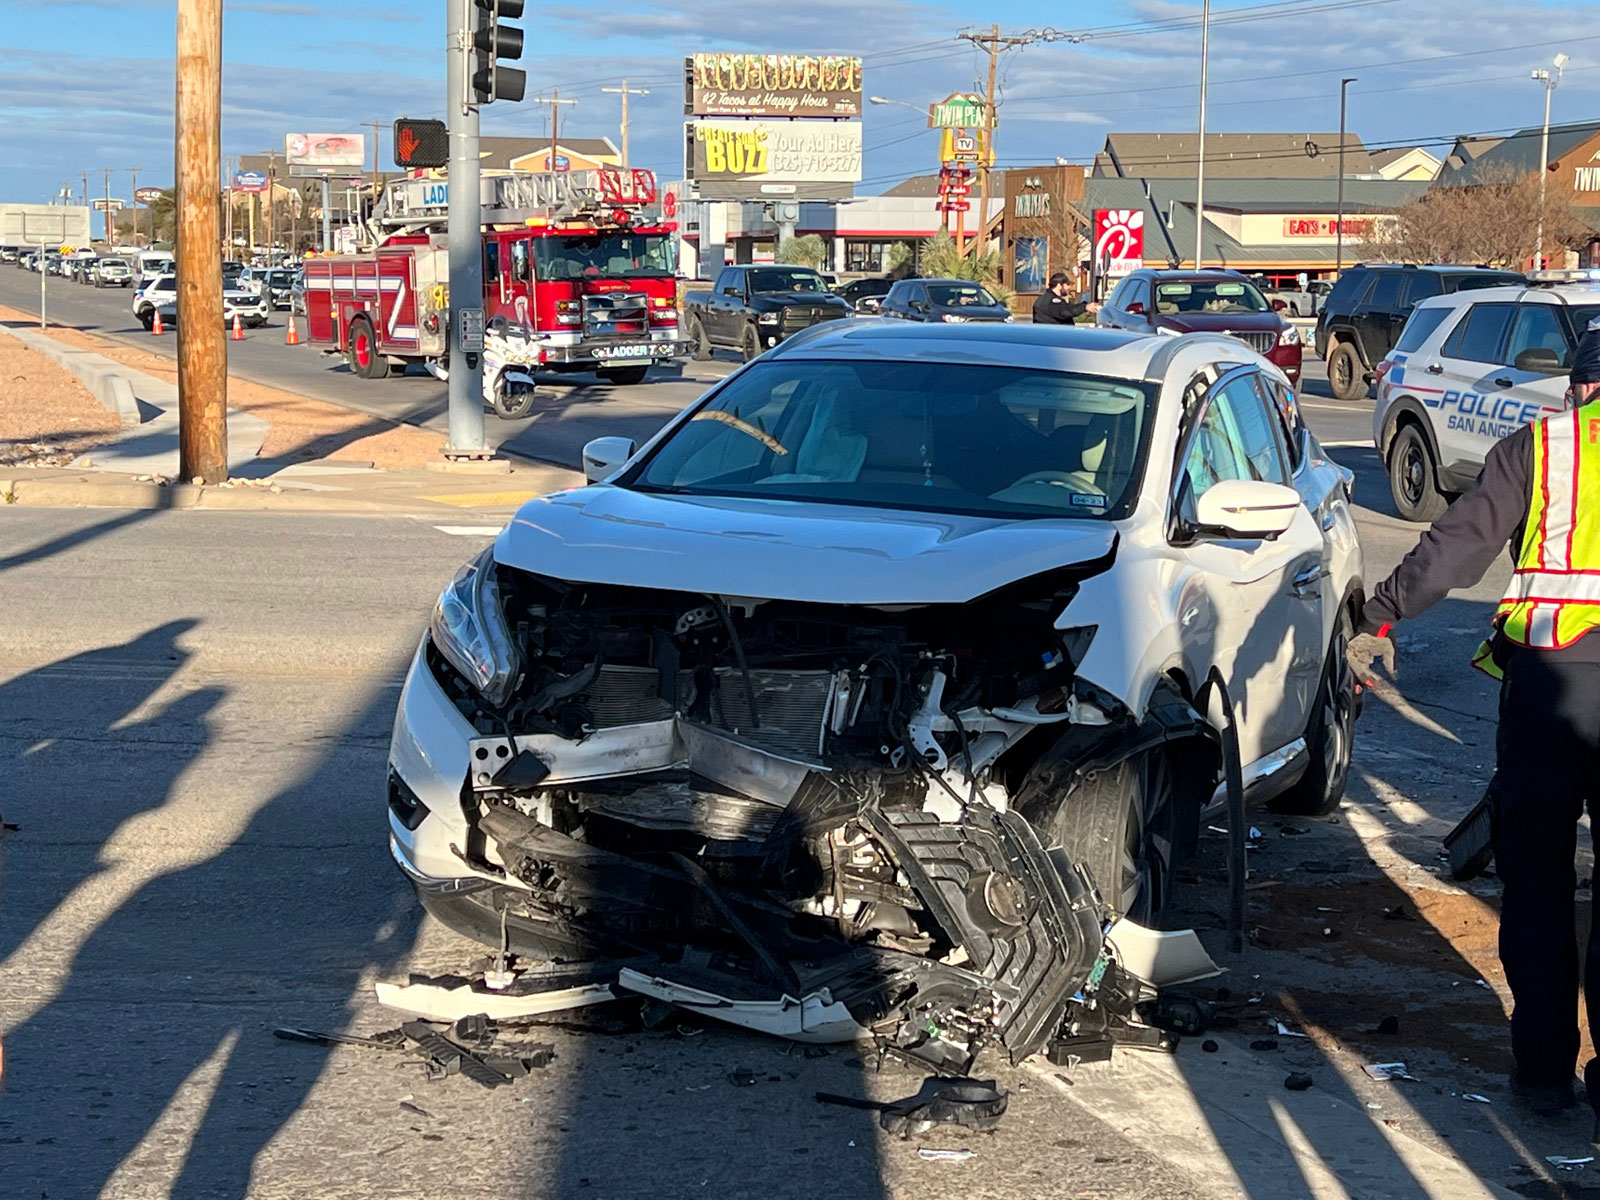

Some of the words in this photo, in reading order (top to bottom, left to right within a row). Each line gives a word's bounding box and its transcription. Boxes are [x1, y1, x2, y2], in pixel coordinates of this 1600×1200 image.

[702, 92, 717, 105] $2
[718, 92, 746, 106] Tacos
[748, 94, 762, 106] at
[762, 92, 798, 112] Happy
[800, 93, 829, 107] Hour
[936, 104, 964, 128] TWIN
[696, 127, 736, 144] CREATE
[772, 132, 804, 152] Your
[806, 132, 825, 152] Ad
[827, 132, 862, 153] Here
[705, 138, 768, 174] BUZZ
[1289, 220, 1319, 235] EATS
[606, 344, 648, 357] LADDER
[1440, 389, 1541, 425] POLICE
[1448, 415, 1475, 433] SAN
[1478, 421, 1520, 439] ANGE
